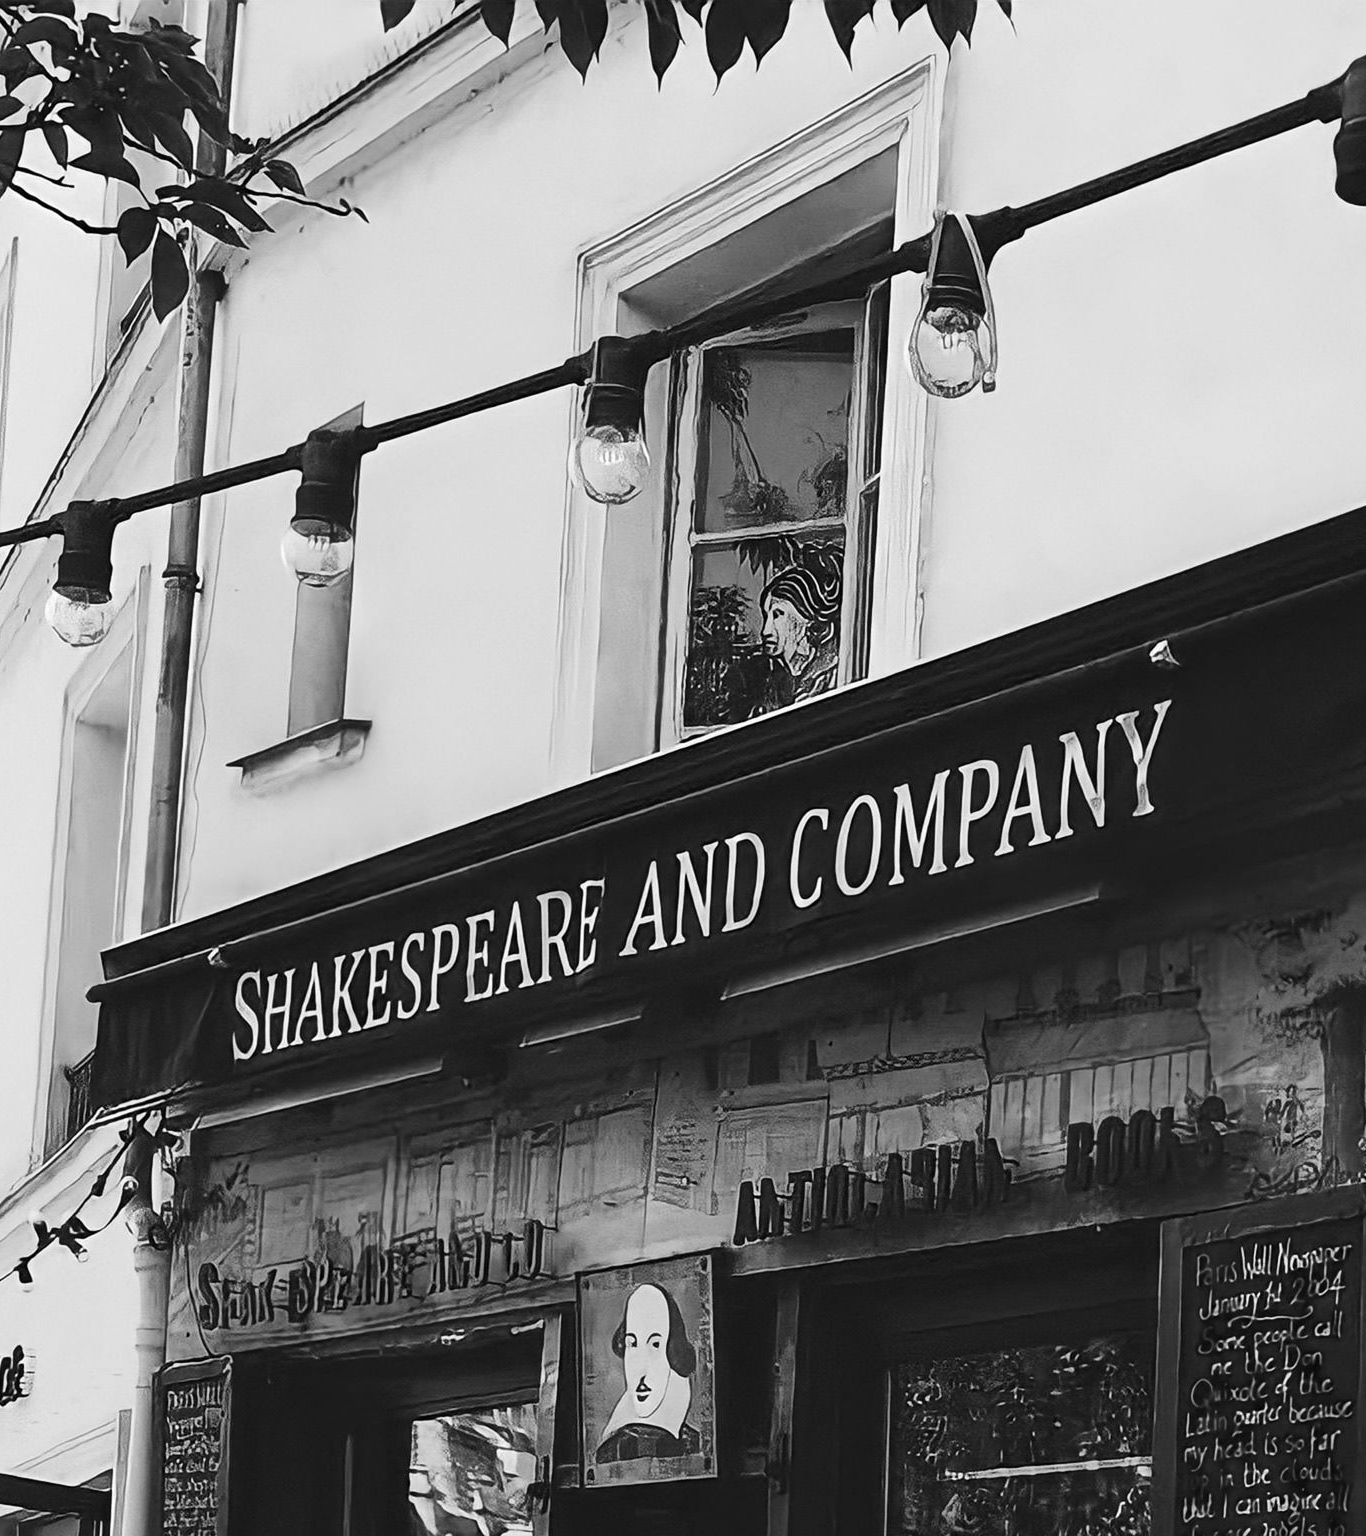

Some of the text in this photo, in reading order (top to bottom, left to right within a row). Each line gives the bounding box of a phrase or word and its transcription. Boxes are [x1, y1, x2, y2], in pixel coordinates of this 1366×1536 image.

[233, 699, 1173, 1060] SHAKESPEARE AND COMPANY
[1065, 1095, 1229, 1192] BOOKS
[1196, 1253, 1237, 1287] Paris
[1314, 1309, 1343, 1338] call
[1244, 1351, 1276, 1375] the
[1283, 1344, 1323, 1371] Don
[1299, 1371, 1334, 1395] the
[1185, 1409, 1228, 1438] Latin
[1289, 1396, 1353, 1424] because
[1184, 1425, 1341, 1472] my head is so far
[1244, 1462, 1272, 1487] the
[1280, 1457, 1343, 1483] clouds
[1235, 1498, 1260, 1514] can
[1326, 1484, 1350, 1512] all
